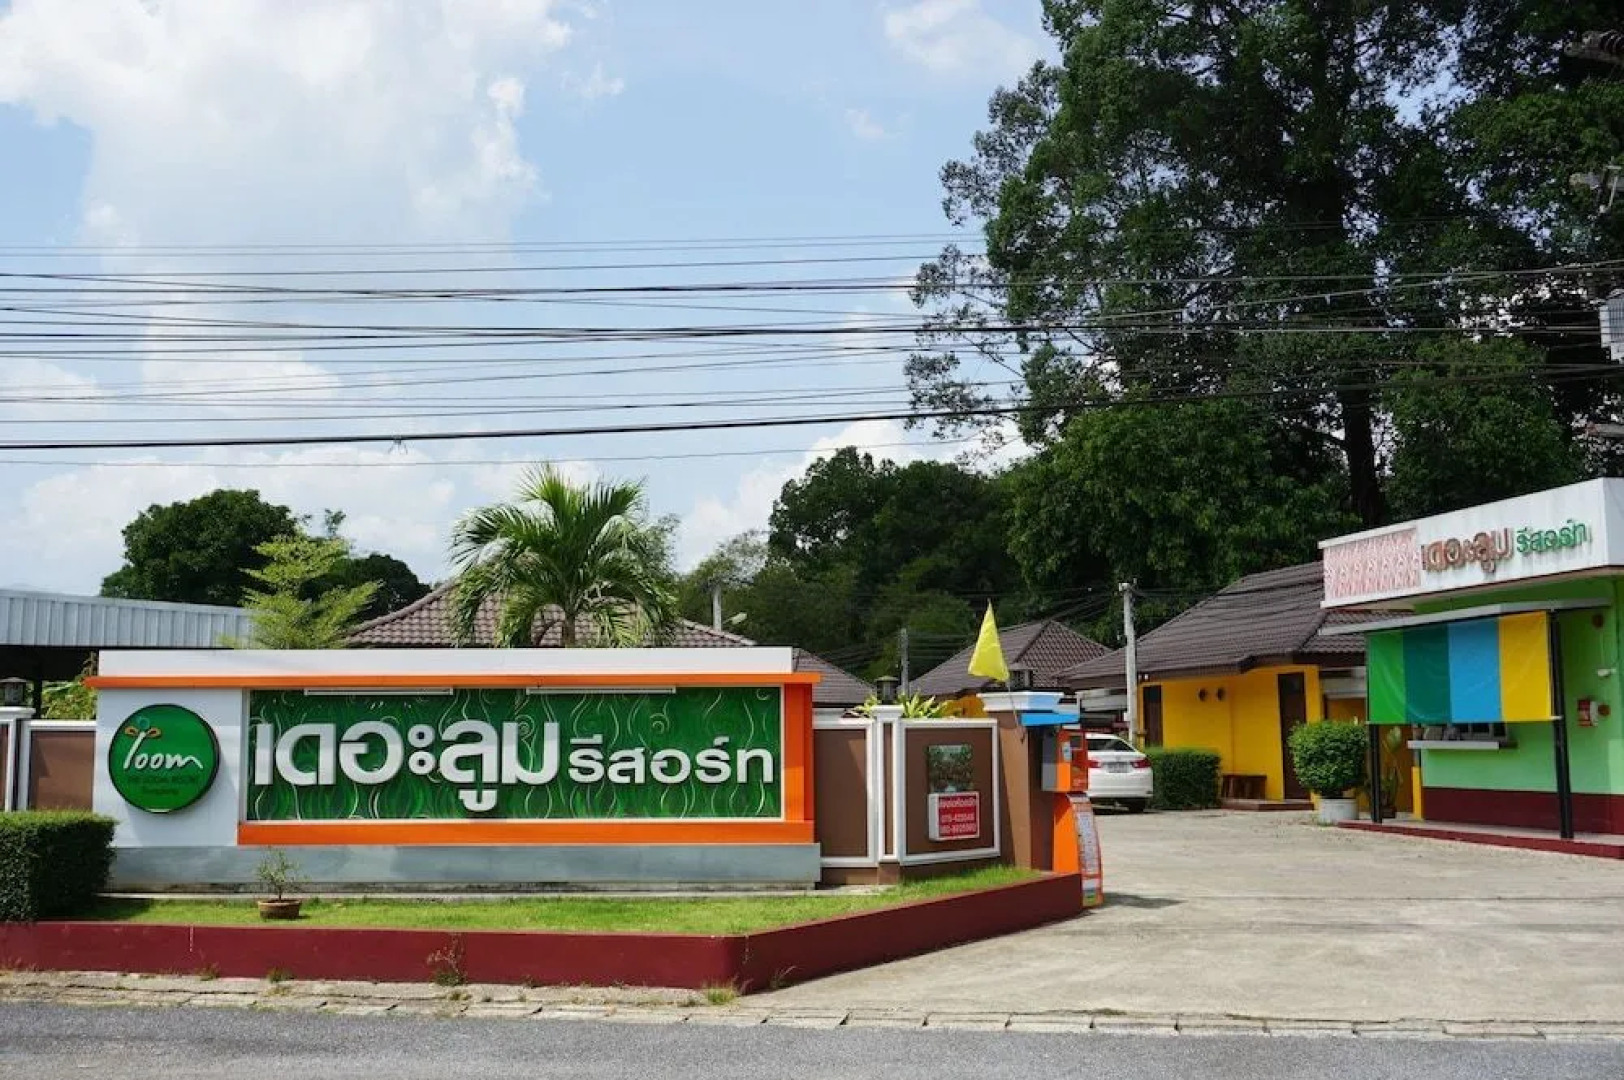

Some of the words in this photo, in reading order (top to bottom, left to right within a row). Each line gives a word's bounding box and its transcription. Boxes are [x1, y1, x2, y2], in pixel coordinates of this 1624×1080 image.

[253, 720, 560, 812] เดอะลูม
[567, 735, 774, 785] รีสอร์ท
